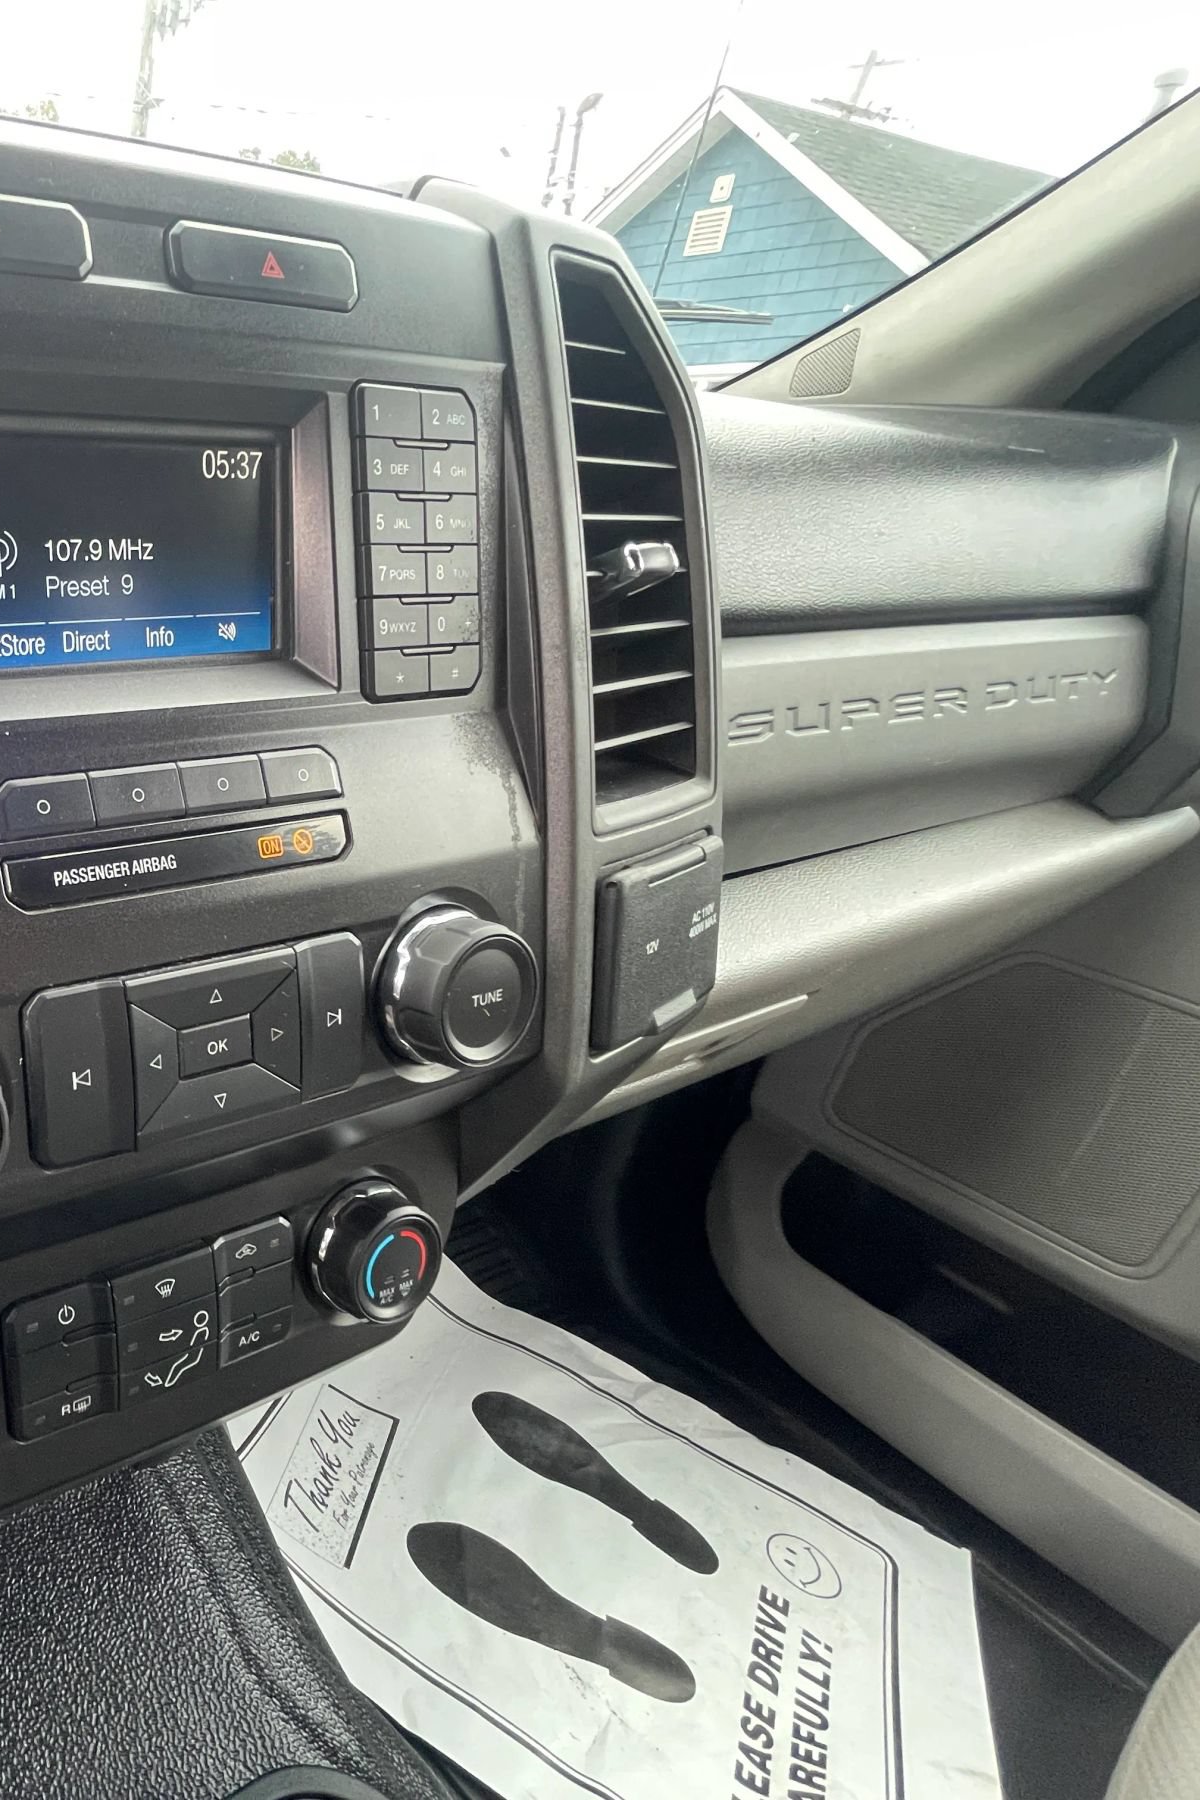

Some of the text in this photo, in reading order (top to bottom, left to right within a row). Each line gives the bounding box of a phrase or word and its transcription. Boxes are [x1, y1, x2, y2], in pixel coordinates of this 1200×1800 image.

[371, 404, 379, 421] 1
[431, 408, 466, 426] 2 ABC
[201, 450, 263, 480] 05:37
[373, 458, 409, 476] 3 DEF
[432, 460, 441, 477] 4
[376, 513, 411, 530] 5 JKL
[435, 513, 444, 531] 6
[44, 538, 154, 563] 107.9 MHz
[378, 565, 387, 582] 7
[436, 564, 445, 581] 8
[9, 584, 17, 600] 1
[46, 574, 134, 599] Preset 9
[379, 618, 417, 636] 9 WXYZ
[437, 616, 446, 632] 0
[63, 630, 111, 654] Direct
[145, 626, 175, 649] Info
[727, 668, 1118, 747] SUPER DUTY
[262, 839, 280, 855] ON
[53, 854, 178, 888] PASSENGER AIRBAG
[691, 909, 702, 925] AC
[646, 938, 660, 956] 12V
[471, 988, 504, 1008] TUNE
[207, 1037, 229, 1055] OK
[238, 1330, 260, 1348] A/C
[61, 1403, 71, 1417] R
[284, 1408, 361, 1533] Thank You
[332, 1441, 379, 1530] For Your Patronage
[746, 1584, 790, 1696] DRIVE
